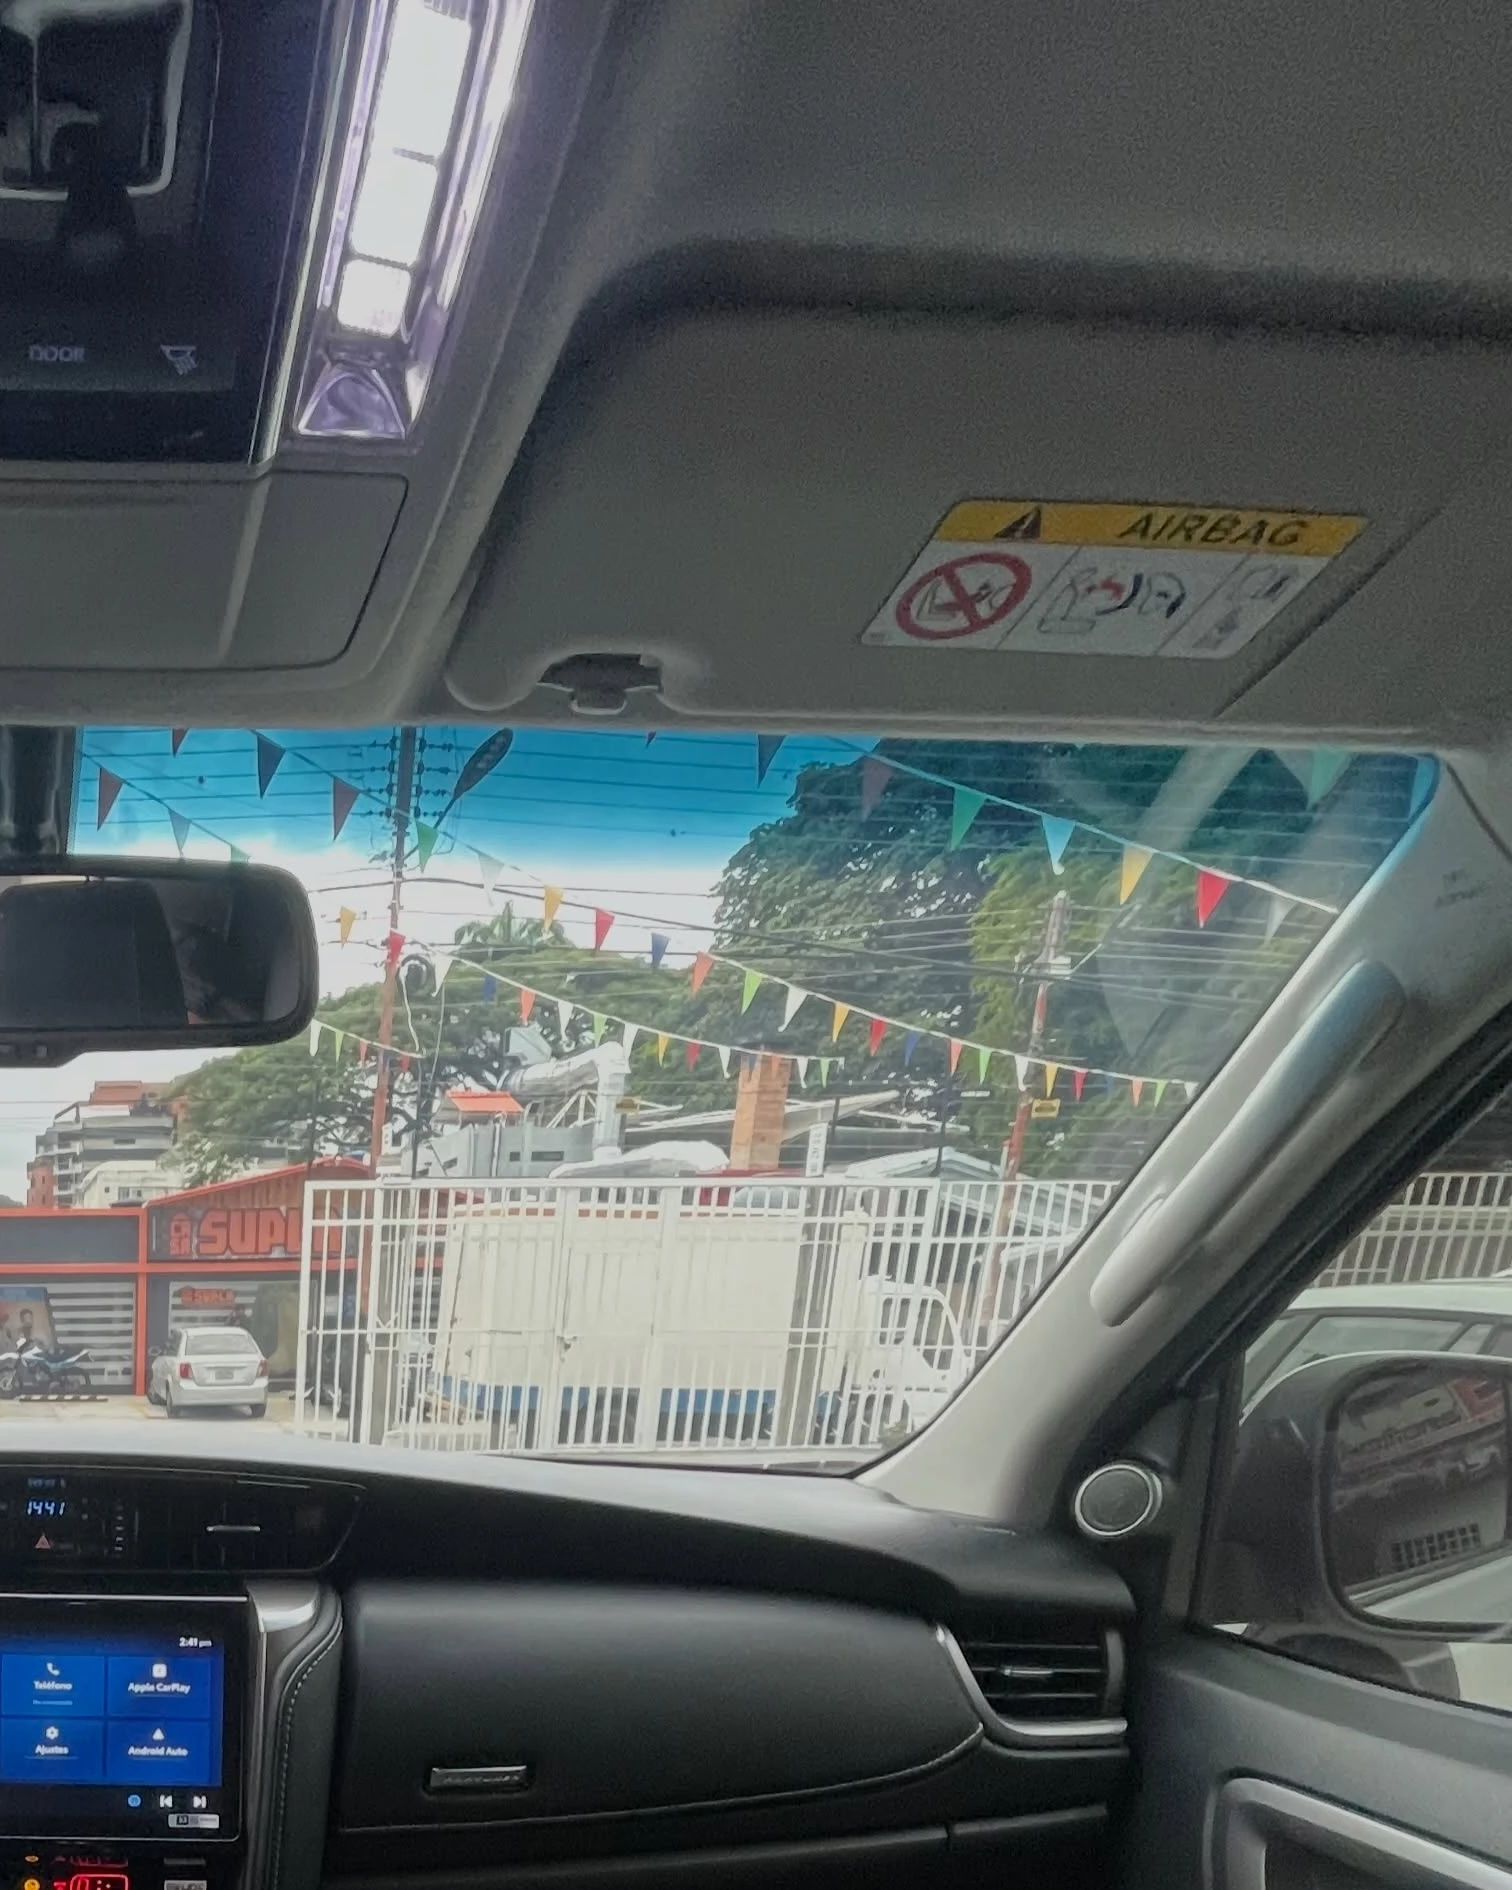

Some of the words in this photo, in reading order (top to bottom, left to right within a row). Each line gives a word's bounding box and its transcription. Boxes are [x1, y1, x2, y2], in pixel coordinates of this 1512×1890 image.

[29, 345, 85, 362] DOOR
[1118, 510, 1312, 546] AIRBAG
[33, 1680, 73, 1691] Teléfono
[127, 1682, 155, 1693] Apple
[155, 1682, 191, 1694] CarPlay
[35, 1744, 69, 1755] Ajustes
[128, 1745, 165, 1756] Android
[165, 1746, 188, 1757] Auto
